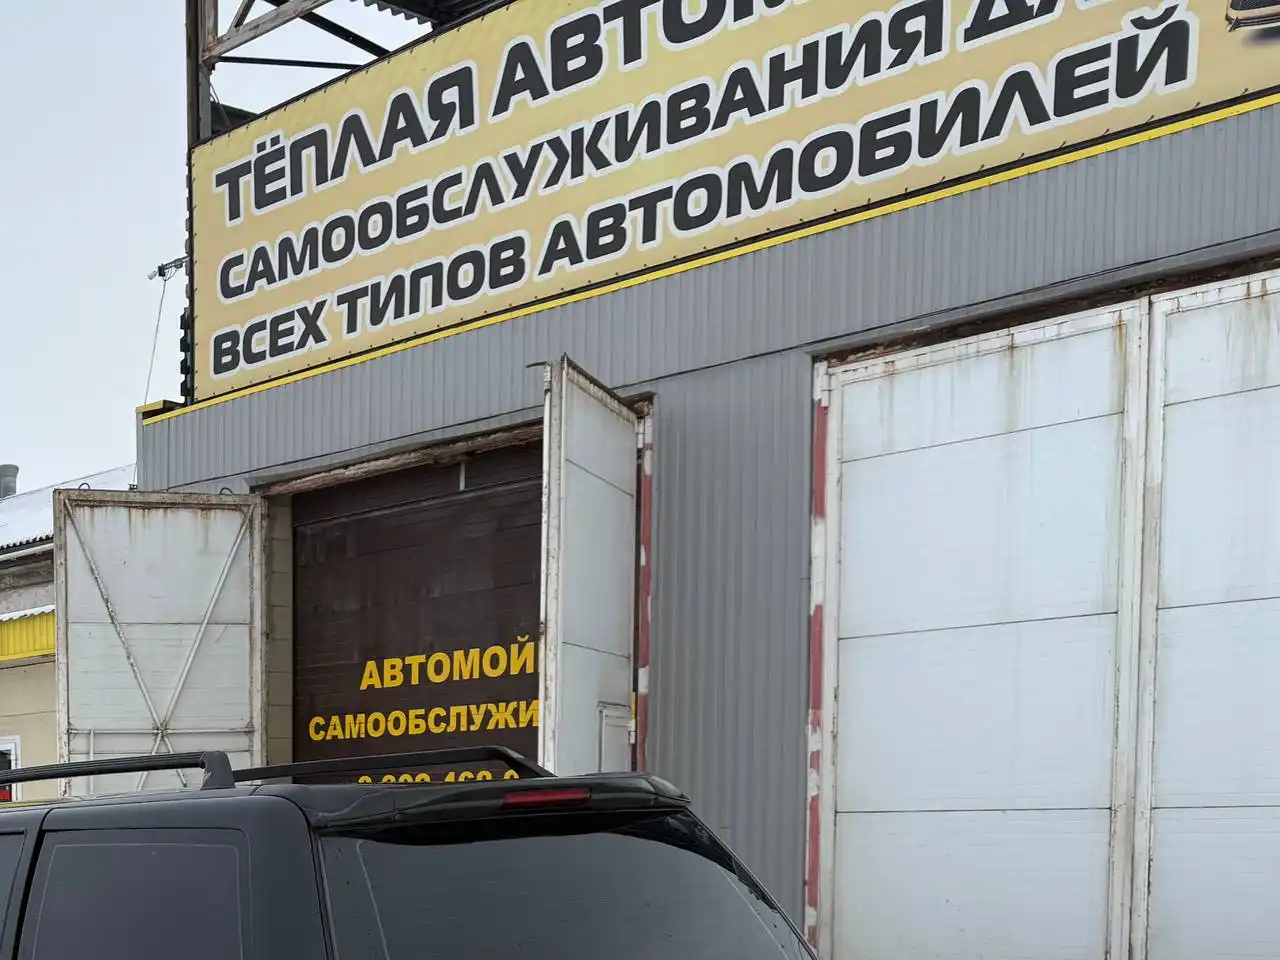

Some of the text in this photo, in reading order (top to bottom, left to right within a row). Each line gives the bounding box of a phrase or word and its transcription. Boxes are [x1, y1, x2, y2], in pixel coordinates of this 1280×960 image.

[213, 4, 1190, 375] ВСЕХ ТИПОВ АВТОМОБИЛЕЙ
[216, 67, 474, 221] ТЁПЛАЯ
[220, 19, 943, 299] САМООБСЛУЖИВАНИЯ
